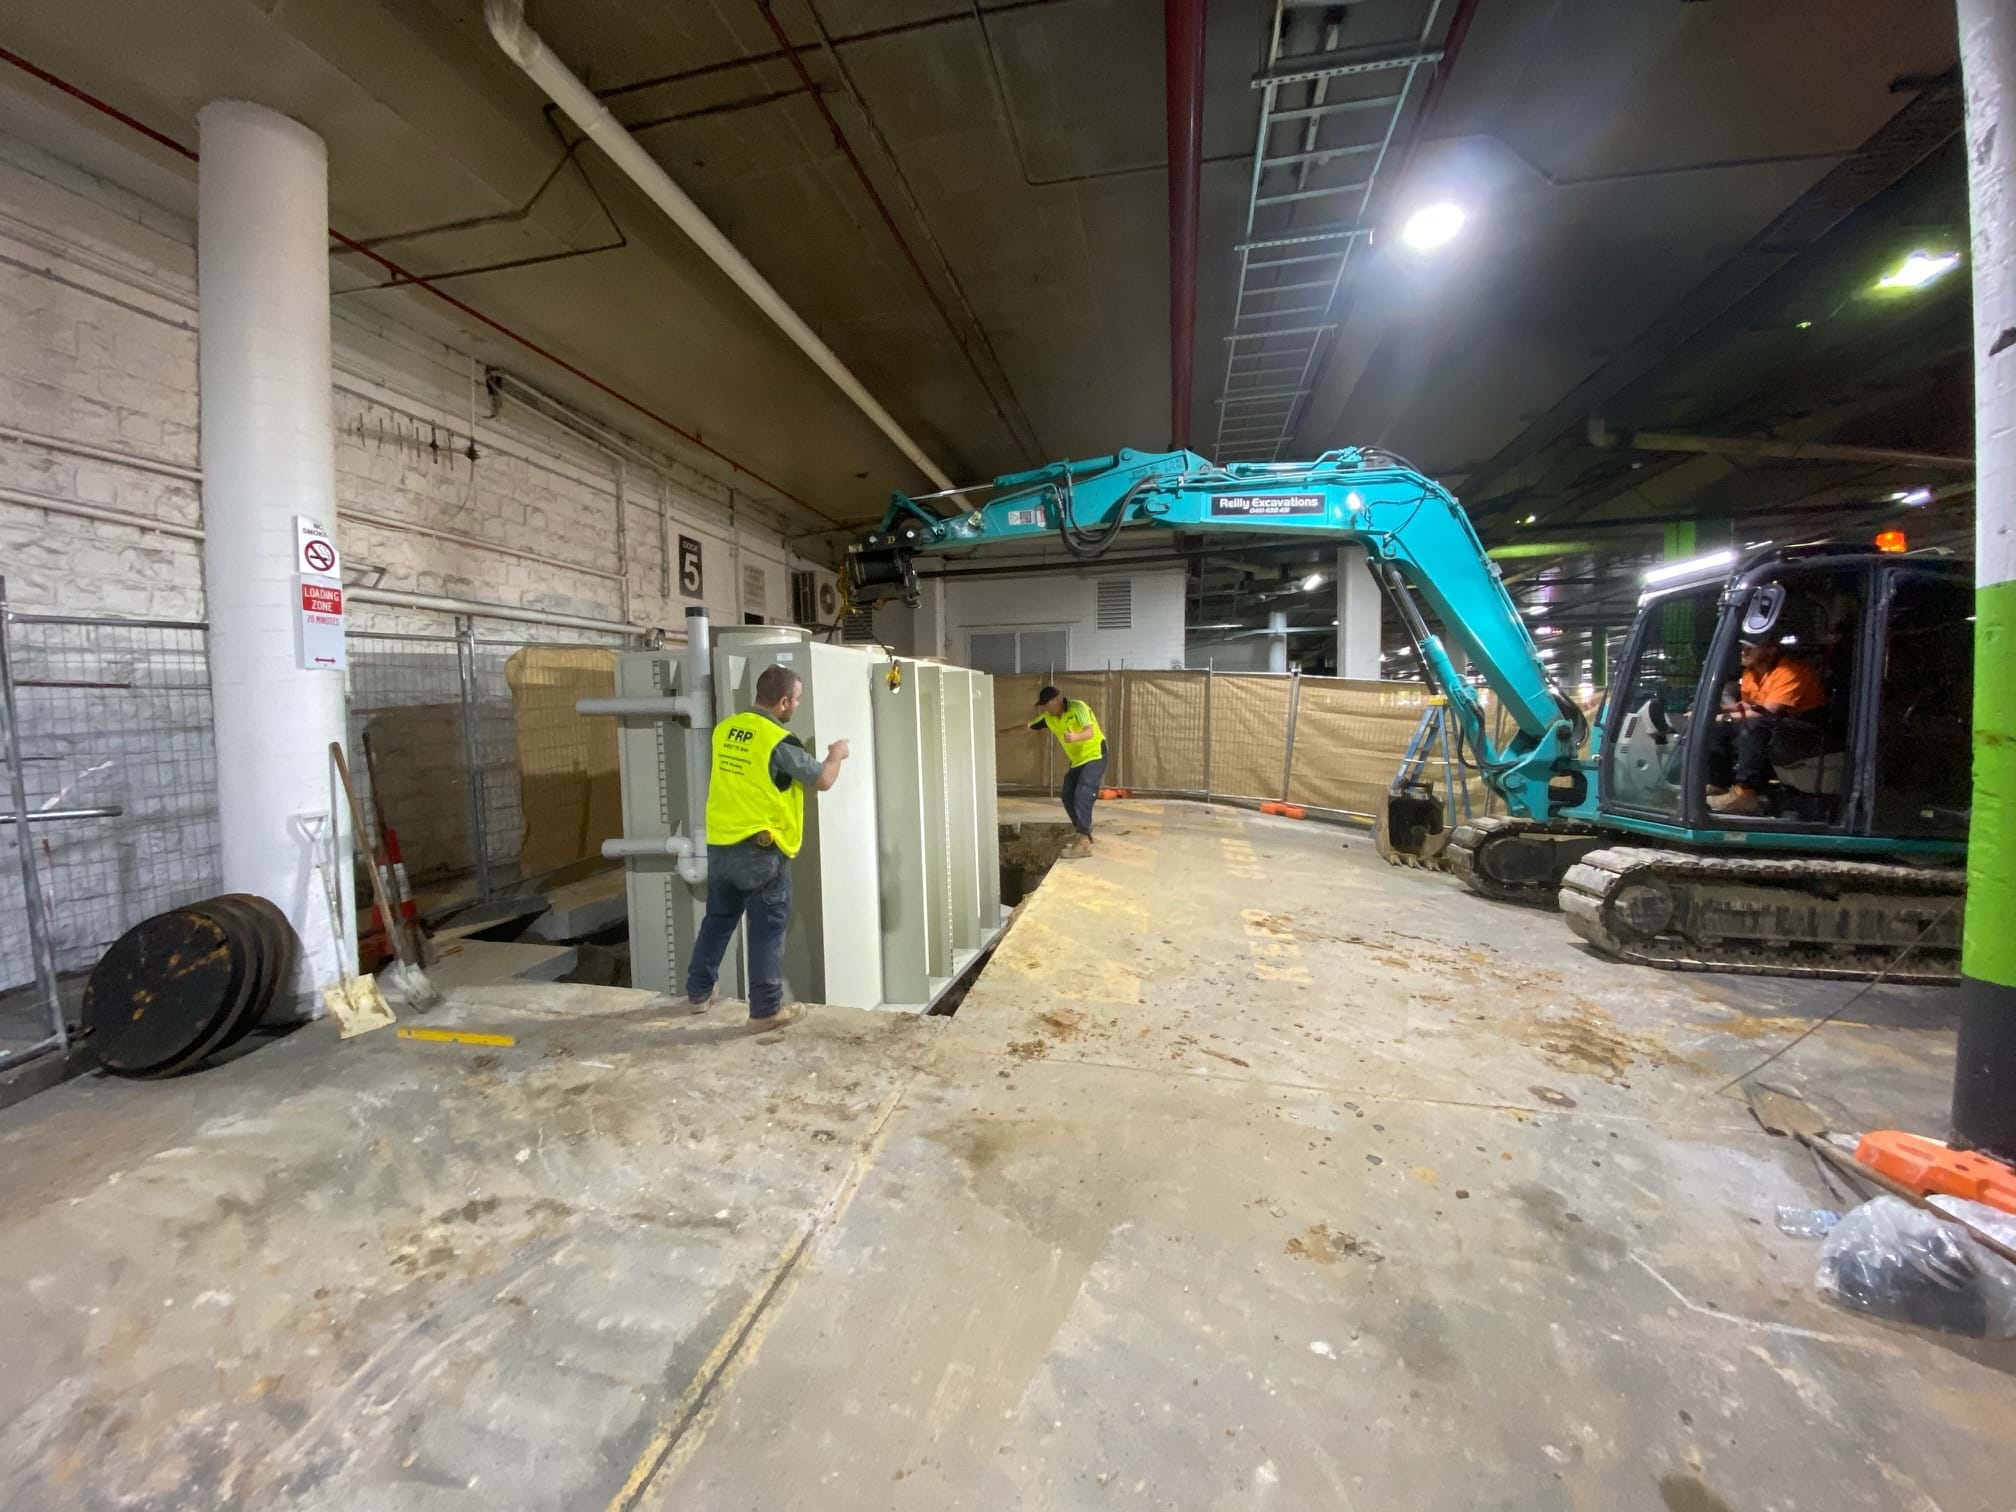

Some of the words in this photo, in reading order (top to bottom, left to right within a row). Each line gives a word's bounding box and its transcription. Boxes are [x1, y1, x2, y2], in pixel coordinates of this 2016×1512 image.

[1219, 498, 1249, 509] Reilly
[1251, 496, 1318, 508] Excavations
[684, 551, 699, 592] 5
[304, 587, 339, 602] LOADING
[311, 599, 333, 612] ZONE
[727, 728, 753, 742] FRP
